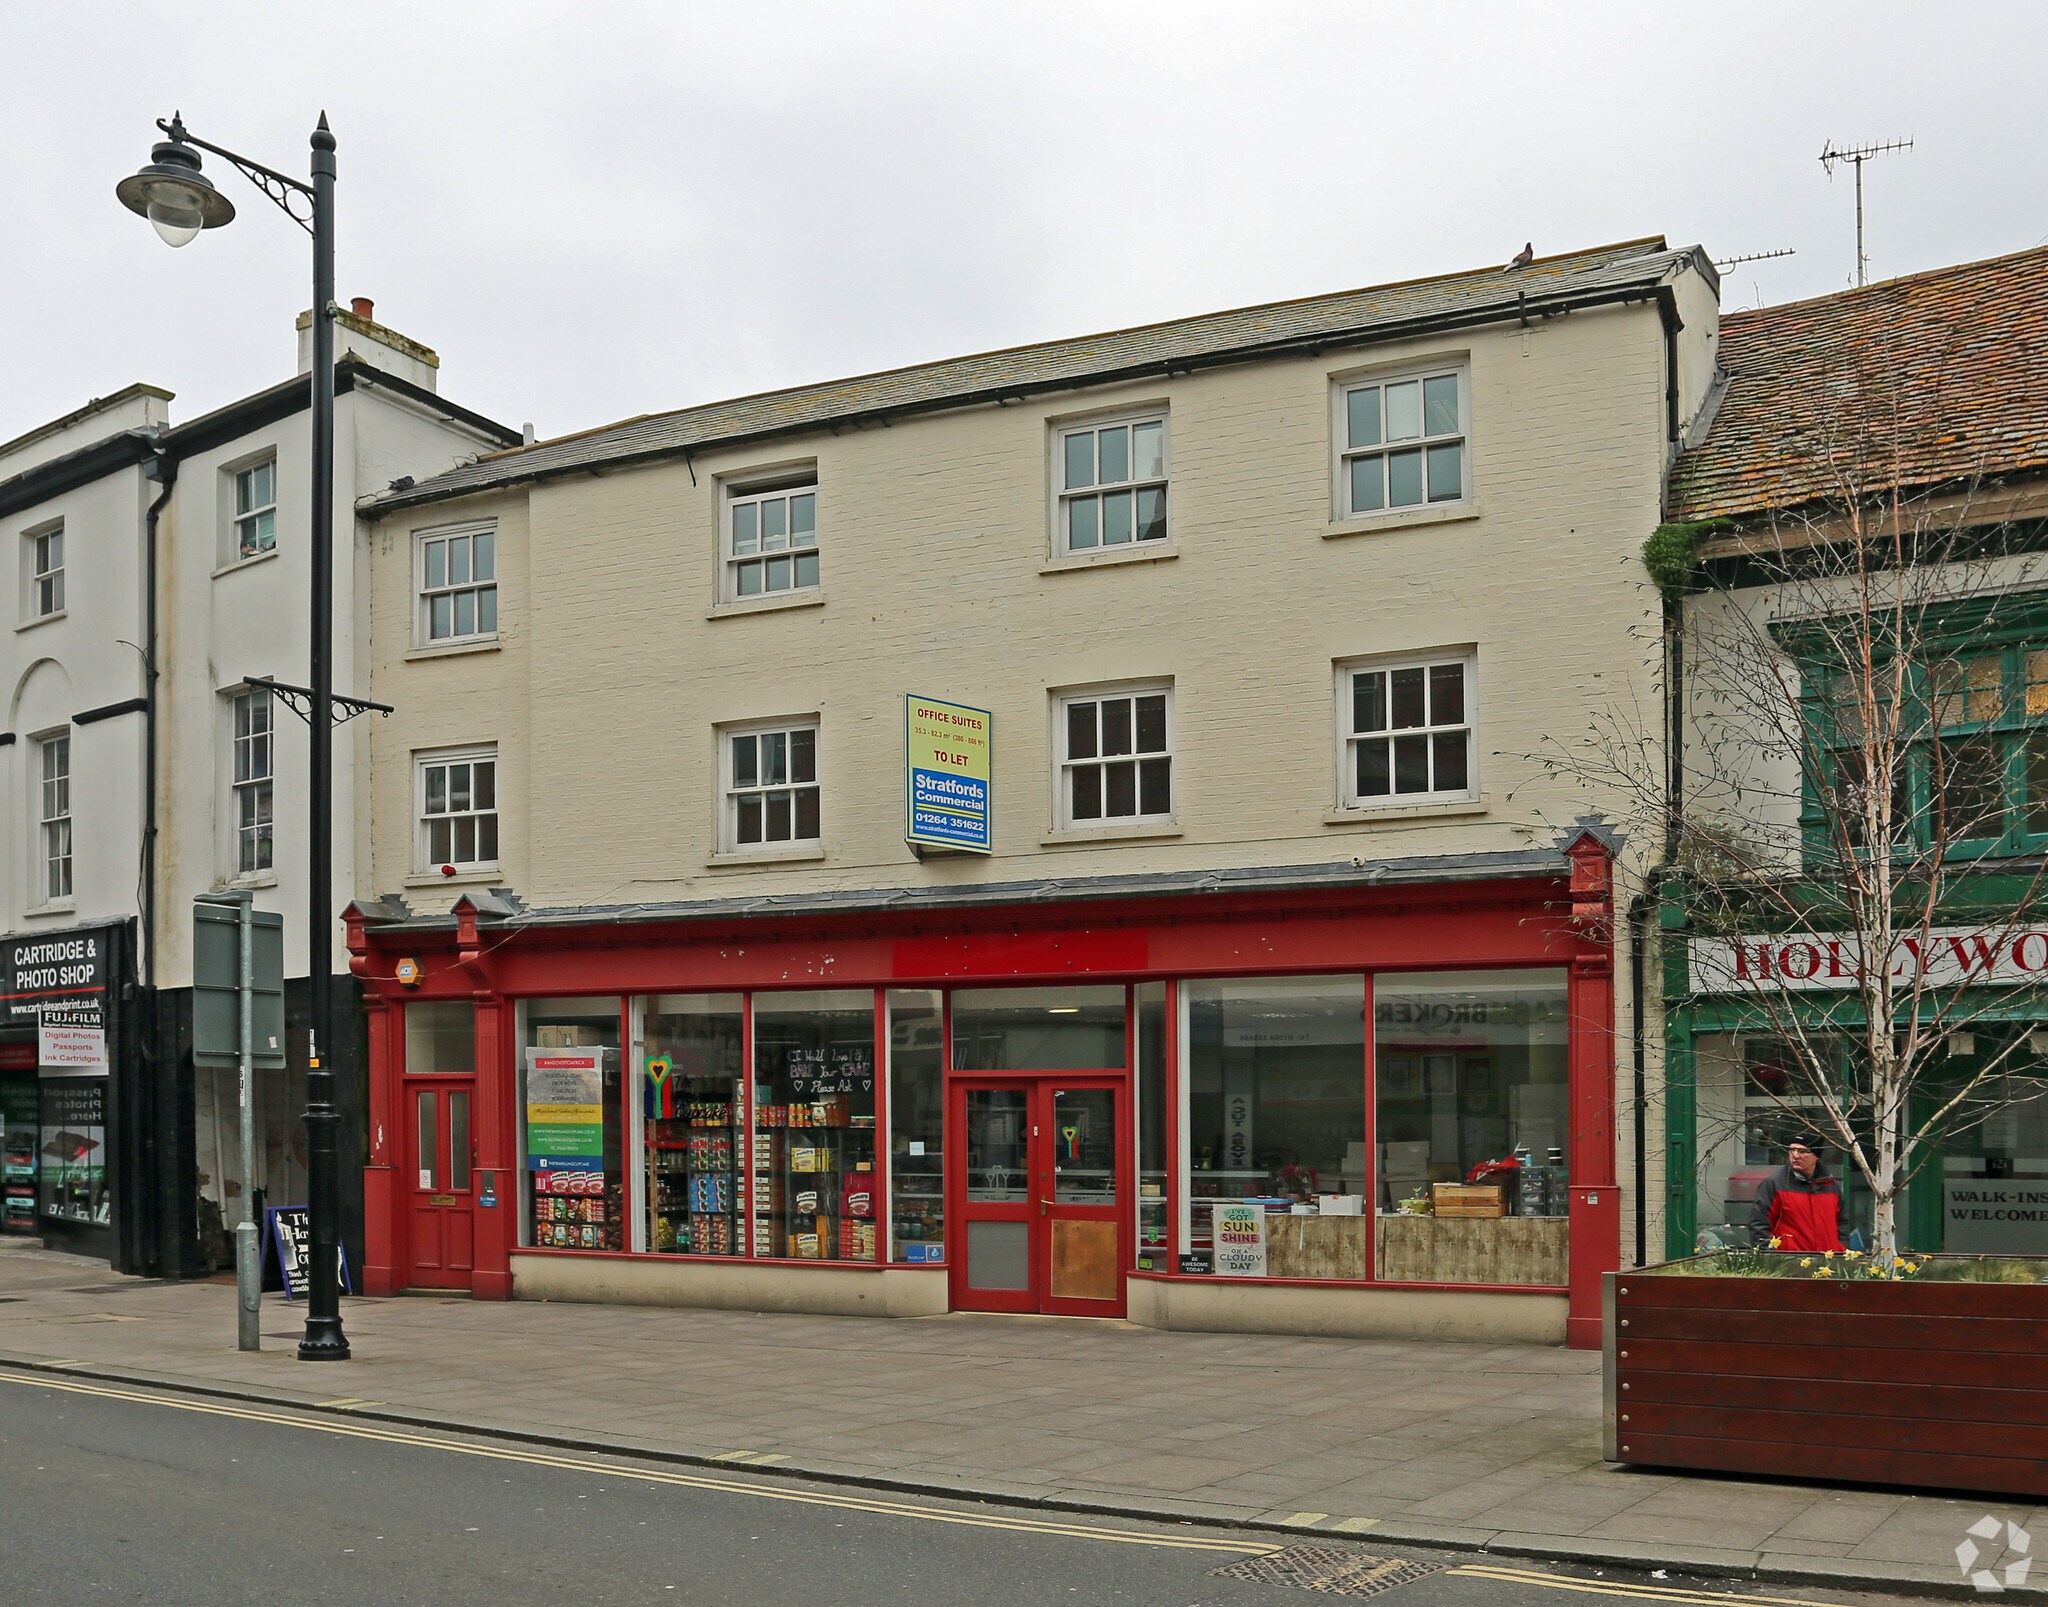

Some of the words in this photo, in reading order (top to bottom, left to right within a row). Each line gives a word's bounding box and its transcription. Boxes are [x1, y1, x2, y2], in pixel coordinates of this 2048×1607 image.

[917, 708, 949, 724] OFFICE
[951, 715, 982, 730] SUITES
[934, 750, 948, 762] TO
[950, 753, 968, 766] LET
[916, 774, 984, 799] Stratfords
[916, 790, 984, 811] Commercial
[916, 812, 948, 826] 01264
[950, 817, 984, 832] 351622
[14, 940, 84, 966] CARTRIDGE
[87, 938, 96, 958] &
[16, 968, 57, 990] PHOTO
[60, 964, 95, 986] SHOP
[45, 1032, 70, 1040] Digital
[72, 1032, 100, 1040] Photos
[53, 1043, 93, 1052] Passports
[60, 1055, 101, 1063] Cartridges
[1951, 1190, 2048, 1204] WALK-INS
[1950, 1208, 2048, 1222] WELCOME
[1224, 1222, 1254, 1232] SUN
[1222, 1234, 1257, 1242] SHINE
[1220, 1254, 1262, 1262] CLOUDY
[1230, 1262, 1252, 1270] DAY
